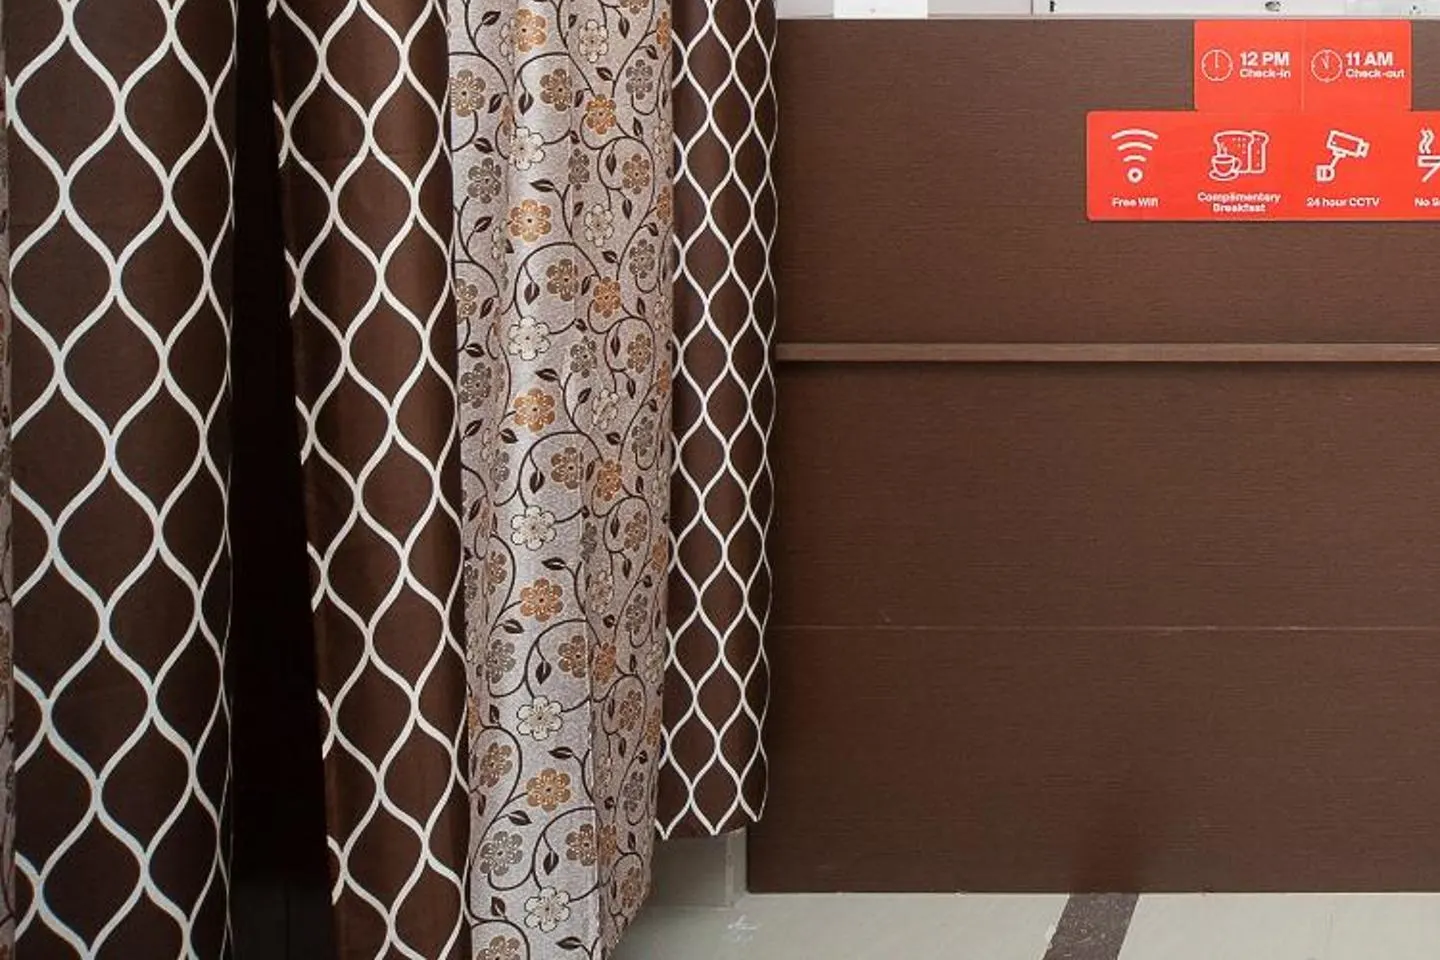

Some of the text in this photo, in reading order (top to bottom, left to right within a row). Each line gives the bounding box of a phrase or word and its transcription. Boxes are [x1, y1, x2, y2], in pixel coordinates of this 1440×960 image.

[1239, 51, 1290, 66] 12 PM
[1345, 51, 1394, 66] 11 AM
[1239, 68, 1291, 78] Check-in
[1345, 68, 1405, 79] Check-out
[1112, 197, 1137, 207] Free
[1197, 191, 1282, 203] Complimentary
[1306, 197, 1380, 207] 24 hour CCTV
[1414, 197, 1430, 207] No
[1212, 203, 1266, 213] Breakfast
